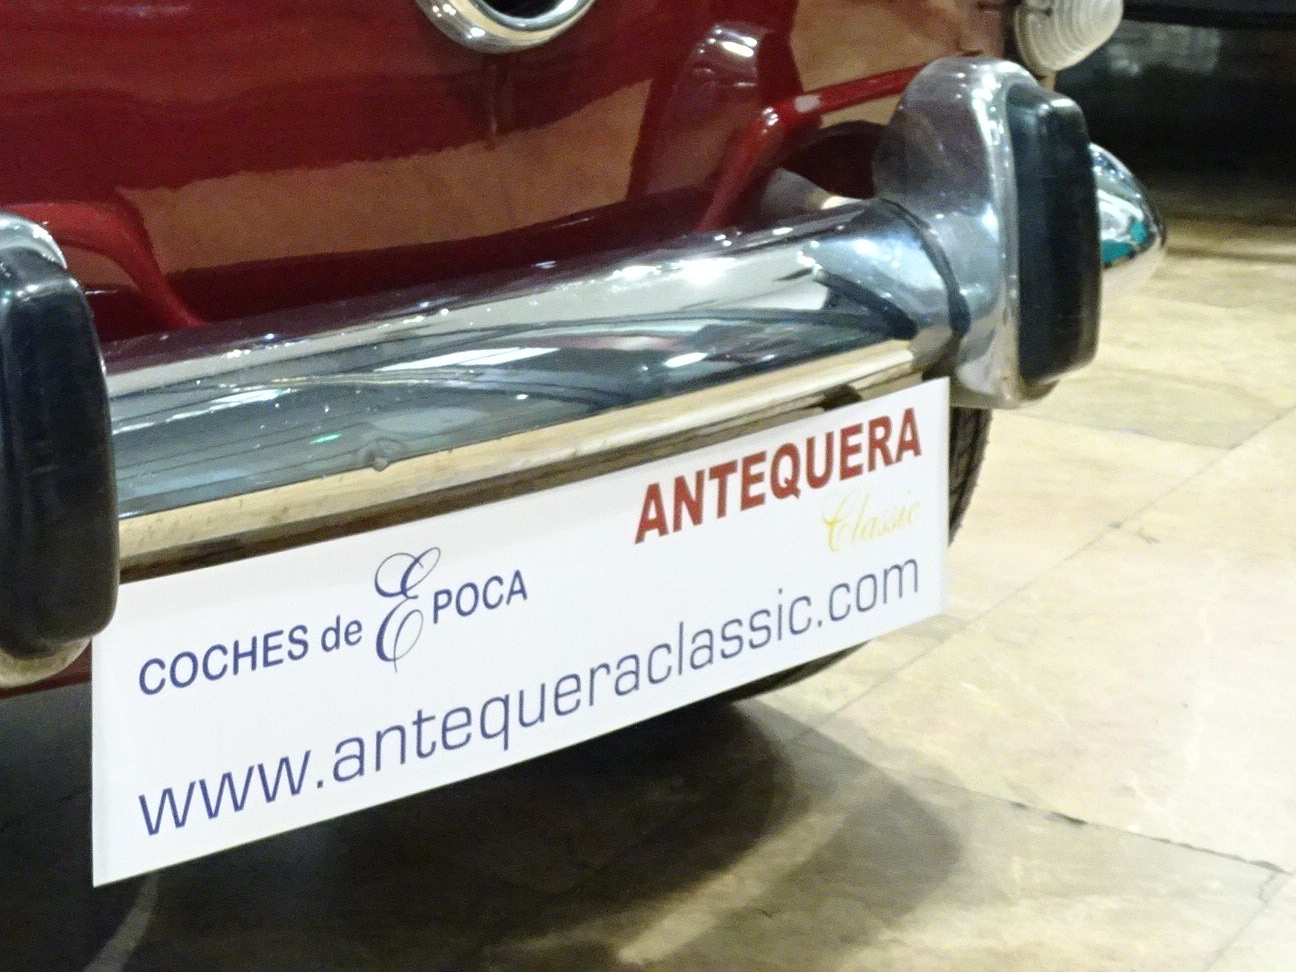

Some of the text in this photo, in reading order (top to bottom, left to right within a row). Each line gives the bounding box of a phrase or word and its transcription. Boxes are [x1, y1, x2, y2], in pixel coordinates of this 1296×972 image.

[634, 406, 922, 544] ANTEQUERA
[822, 488, 921, 553] Classic
[138, 624, 310, 695] COCHES
[320, 614, 363, 653] de
[138, 557, 918, 836] www.antequeraclassic.com
